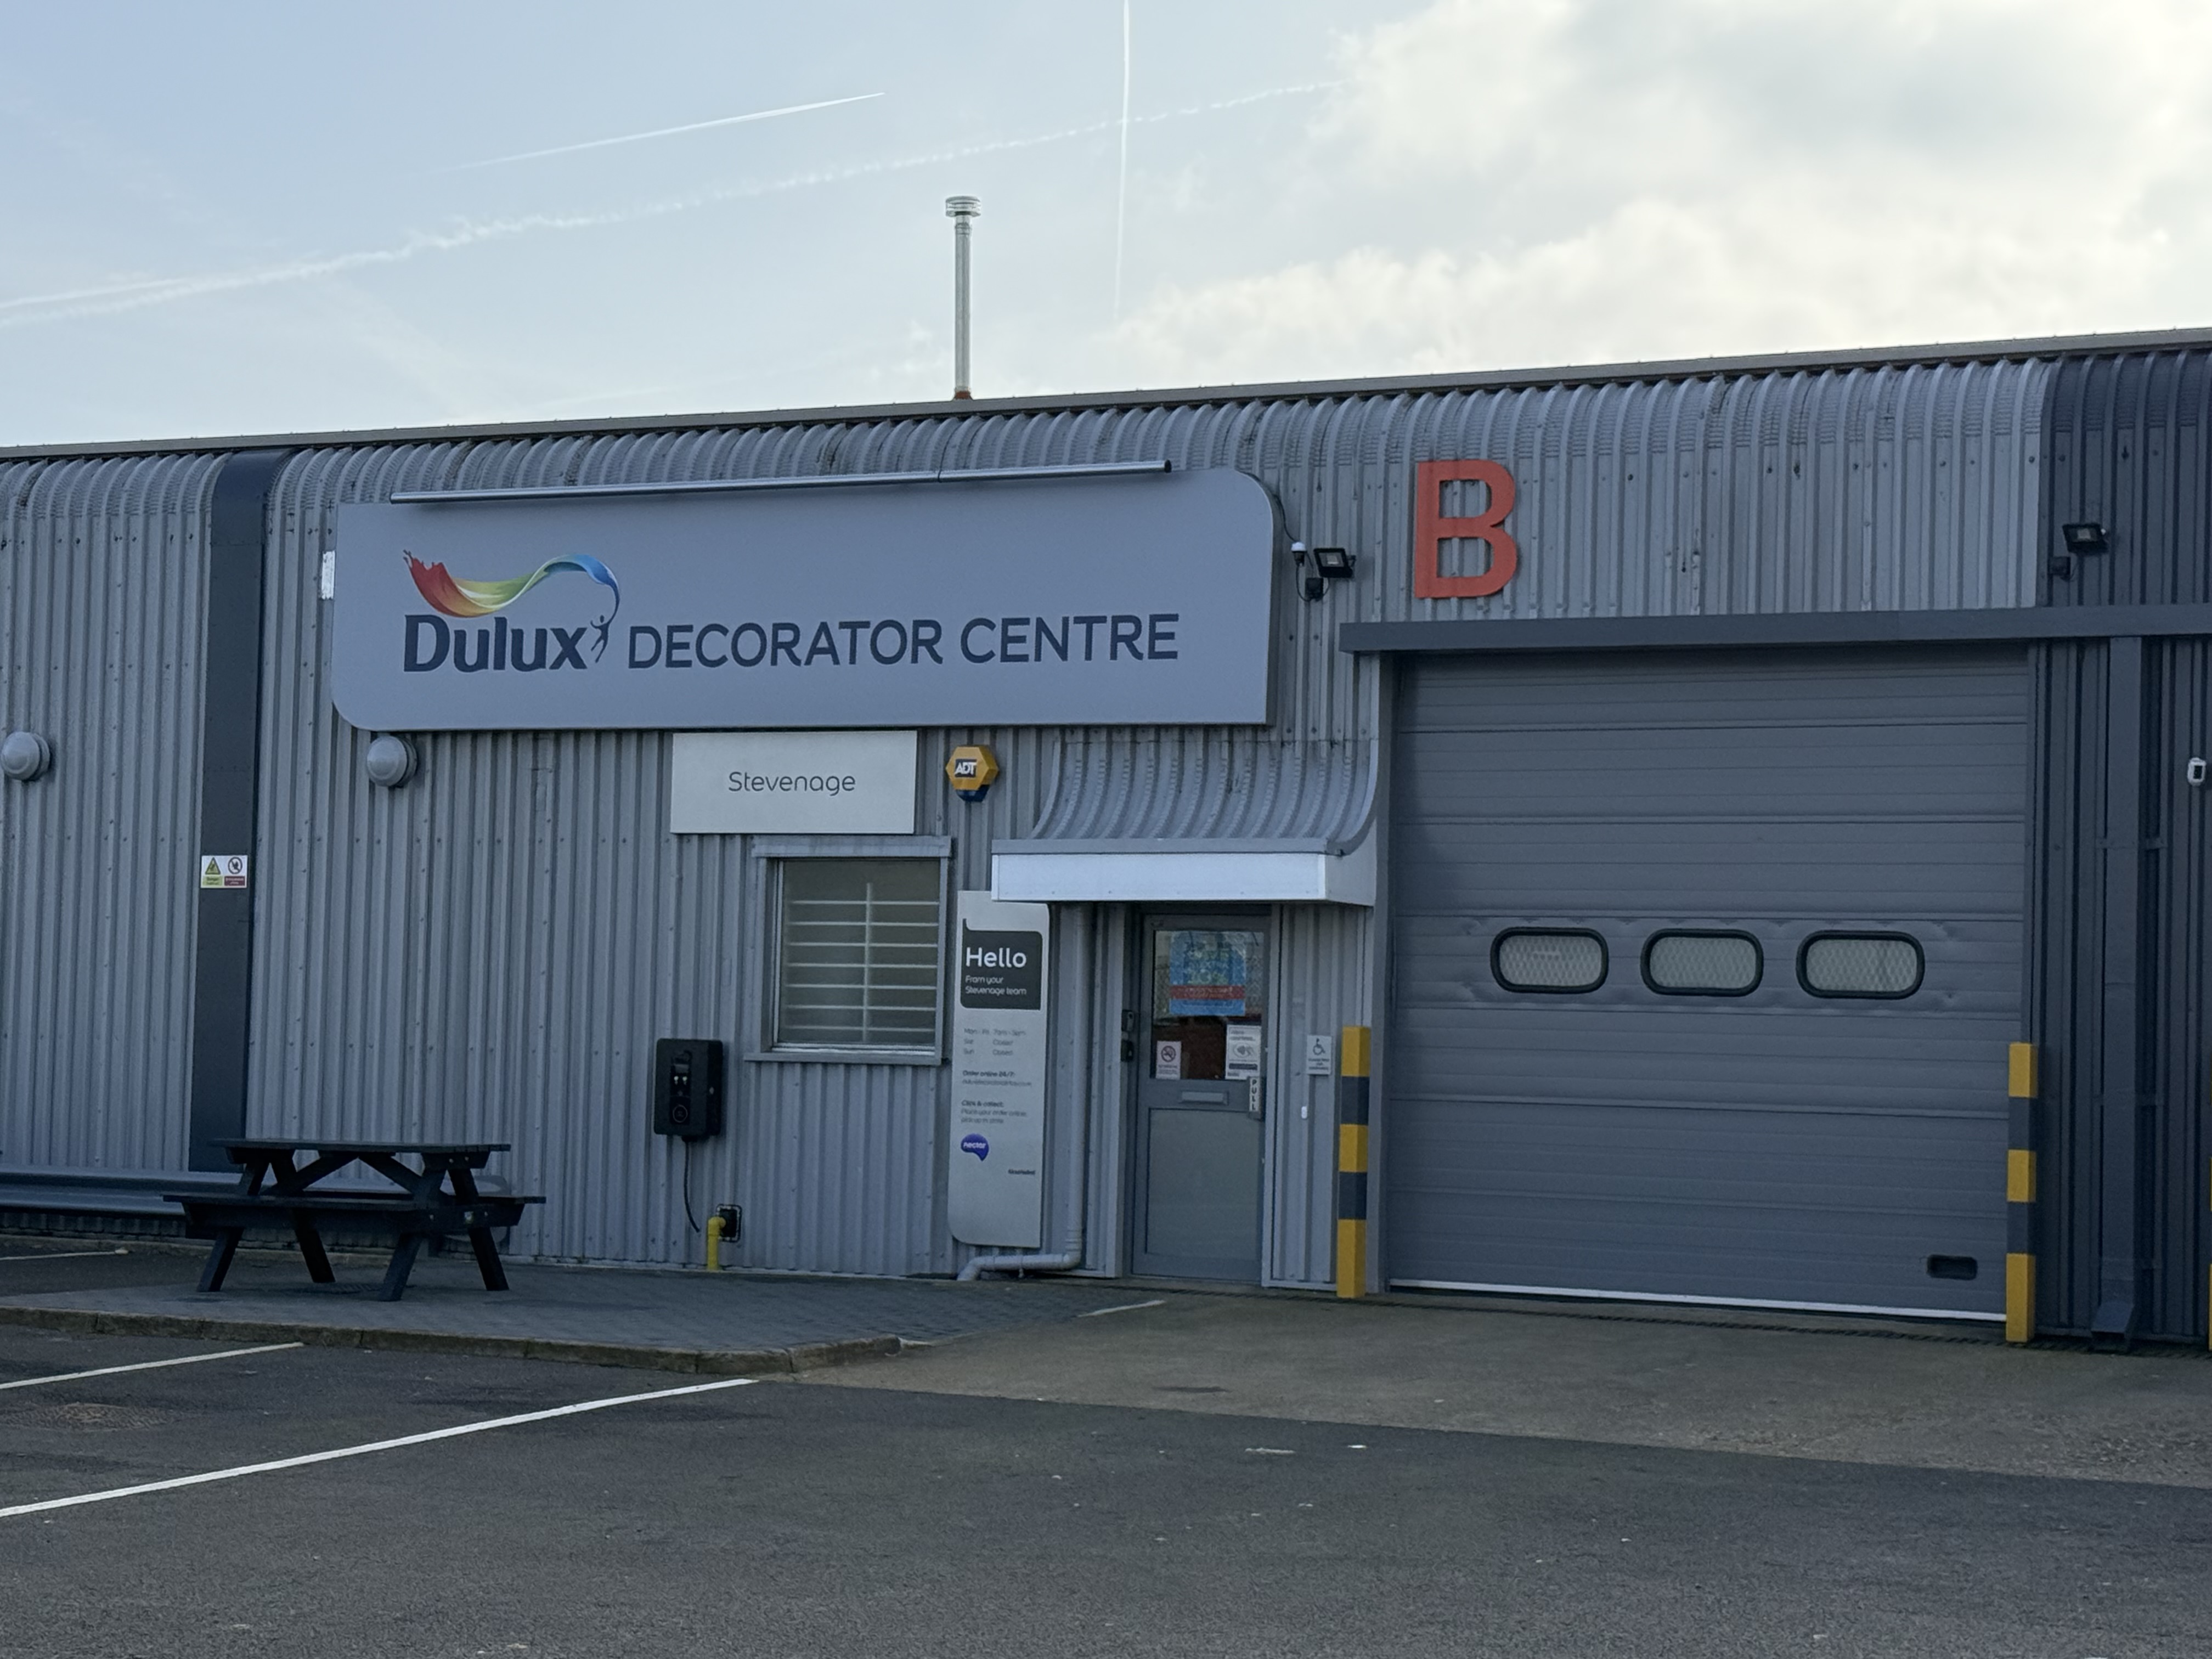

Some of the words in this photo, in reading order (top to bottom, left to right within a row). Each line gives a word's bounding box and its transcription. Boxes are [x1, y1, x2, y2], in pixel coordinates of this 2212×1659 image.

[1414, 459, 1518, 600] B
[404, 614, 588, 673] Dulux
[628, 619, 944, 669] DECORATOR
[960, 613, 1180, 664] CENTRE
[955, 761, 977, 775] ADT
[728, 771, 856, 797] Stevenage
[966, 947, 1027, 968] Hello
[965, 975, 985, 984] From
[986, 977, 1004, 985] your
[965, 986, 1005, 996] Stevenage
[1006, 986, 1027, 995] team
